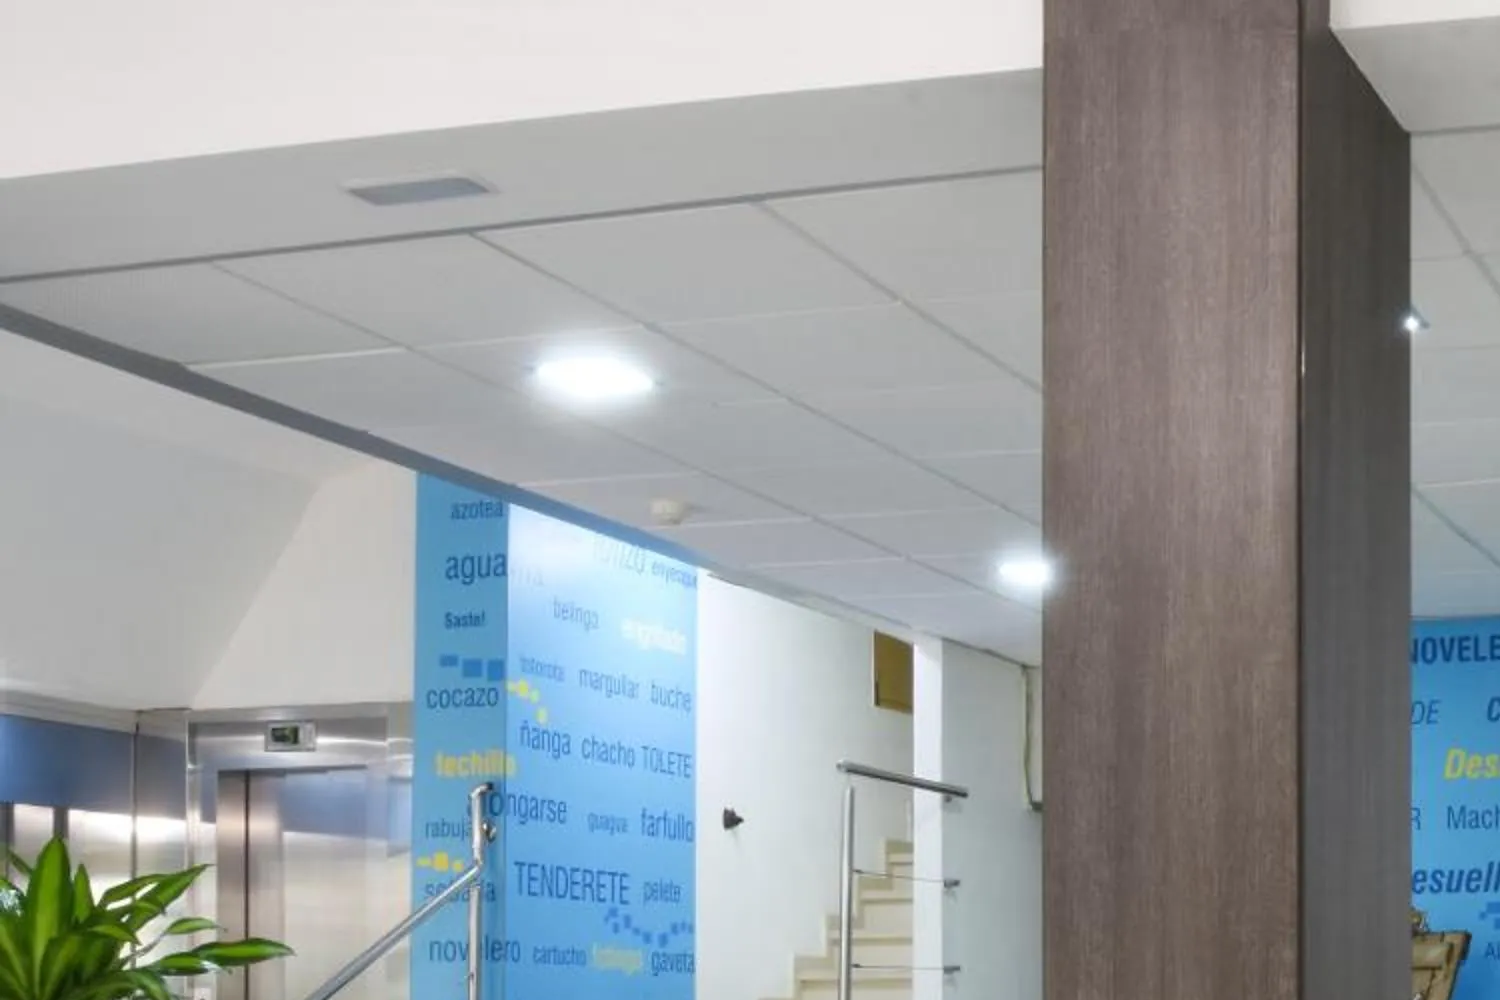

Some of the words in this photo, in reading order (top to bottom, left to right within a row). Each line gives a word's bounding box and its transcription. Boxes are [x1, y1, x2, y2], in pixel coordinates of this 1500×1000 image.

[451, 500, 504, 520] azotea
[581, 735, 635, 769] chacho
[641, 745, 692, 779] TOLETE
[469, 786, 568, 825] ongarse
[641, 806, 694, 843] farfullo
[514, 860, 631, 906] TENDERETE
[429, 934, 521, 964] novlero
